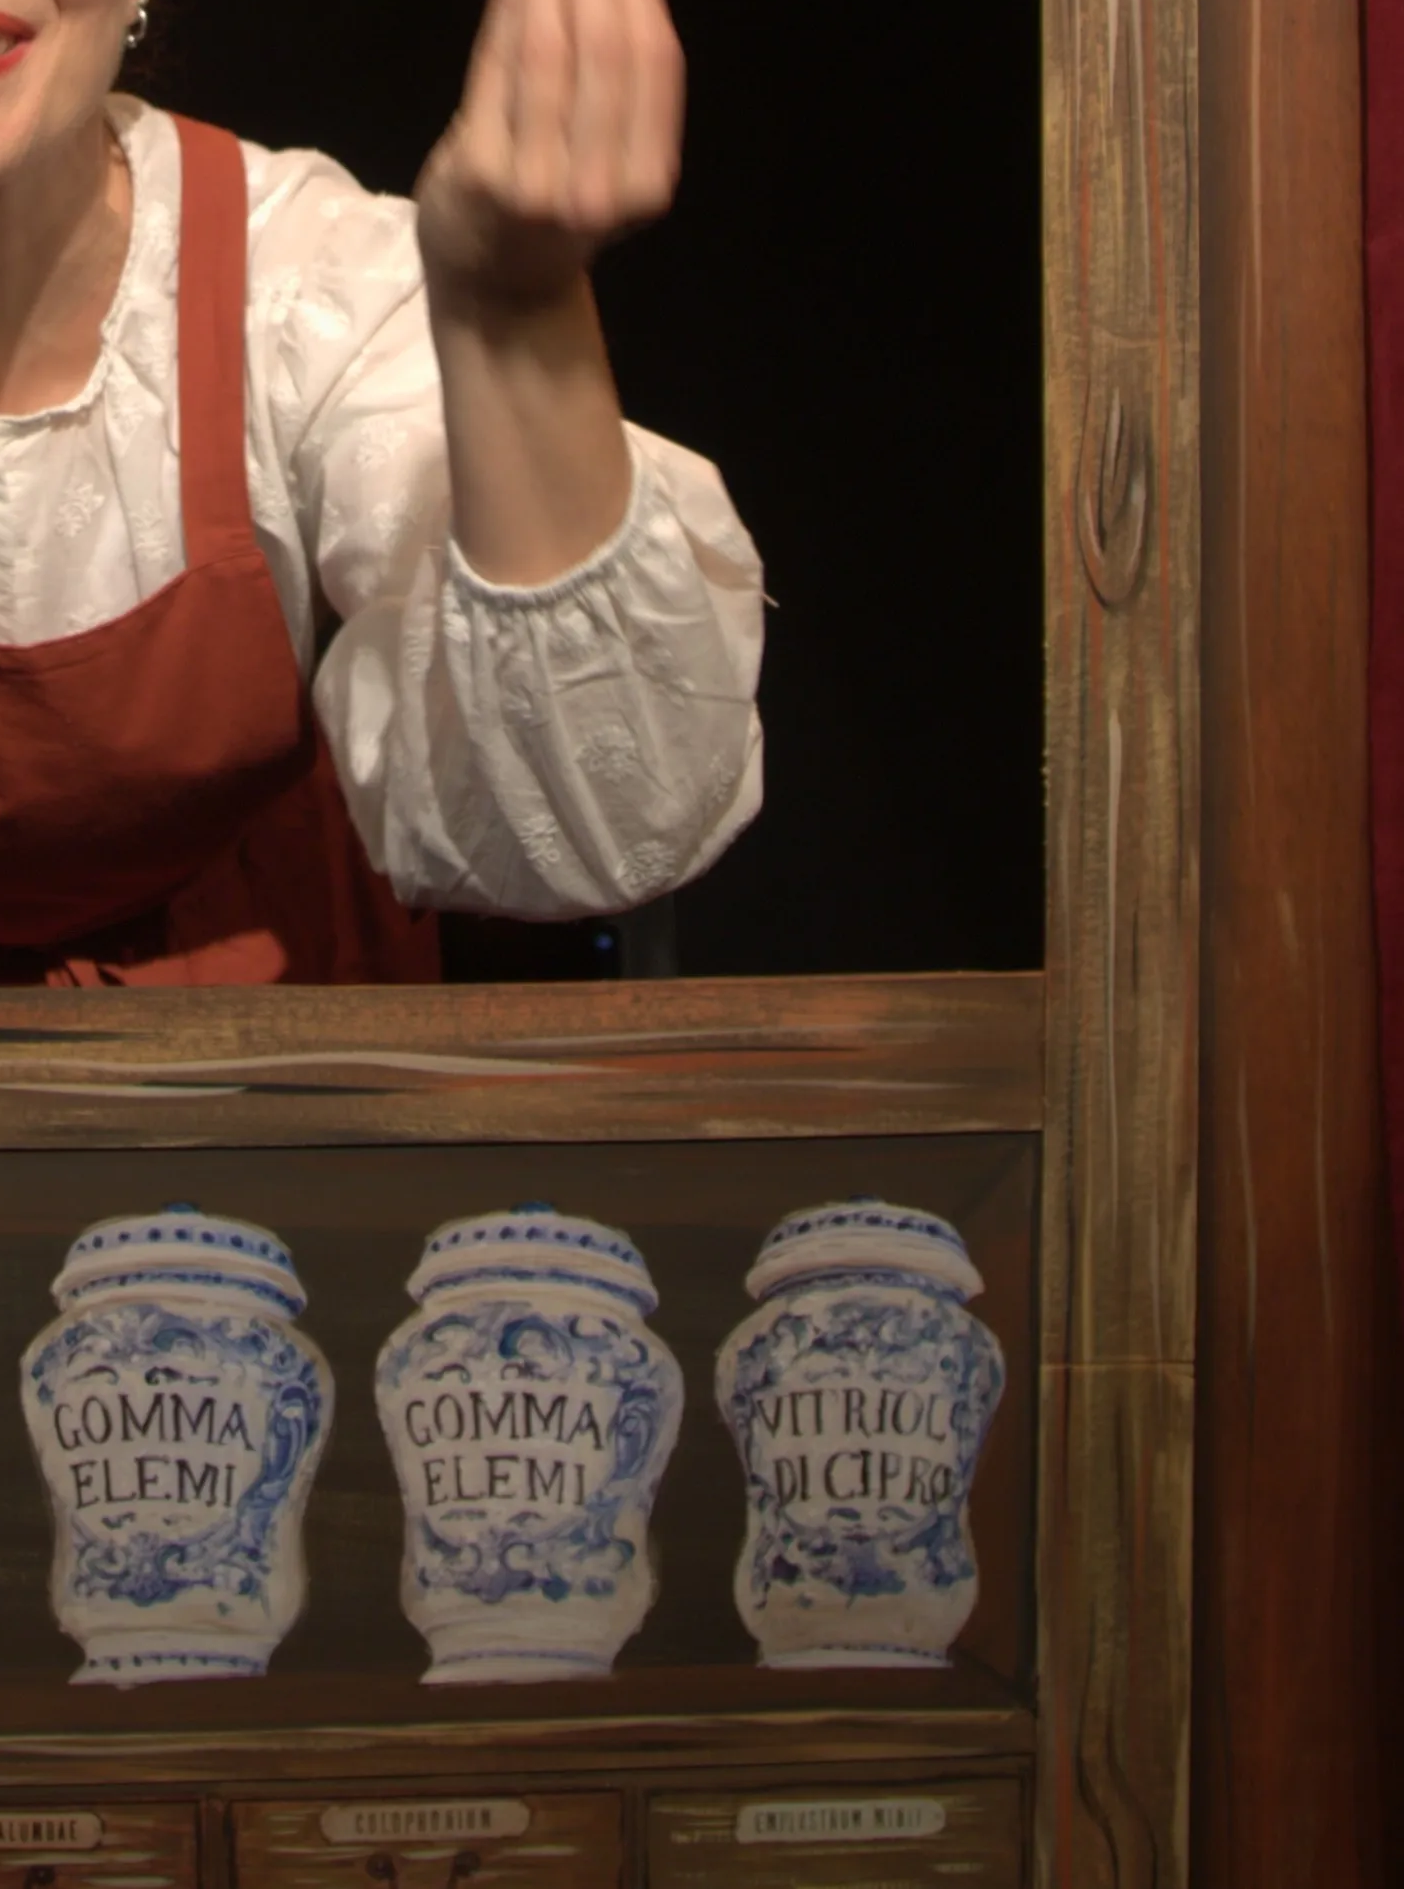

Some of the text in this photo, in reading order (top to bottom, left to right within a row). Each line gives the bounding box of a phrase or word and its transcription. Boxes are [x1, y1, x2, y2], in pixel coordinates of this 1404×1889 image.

[53, 1392, 256, 1452] GOMMA
[404, 1391, 604, 1450] GOMMA
[69, 1456, 237, 1510] ELEMI
[423, 1453, 586, 1507] ELEMI
[774, 1448, 954, 1505] DI CIPRO
